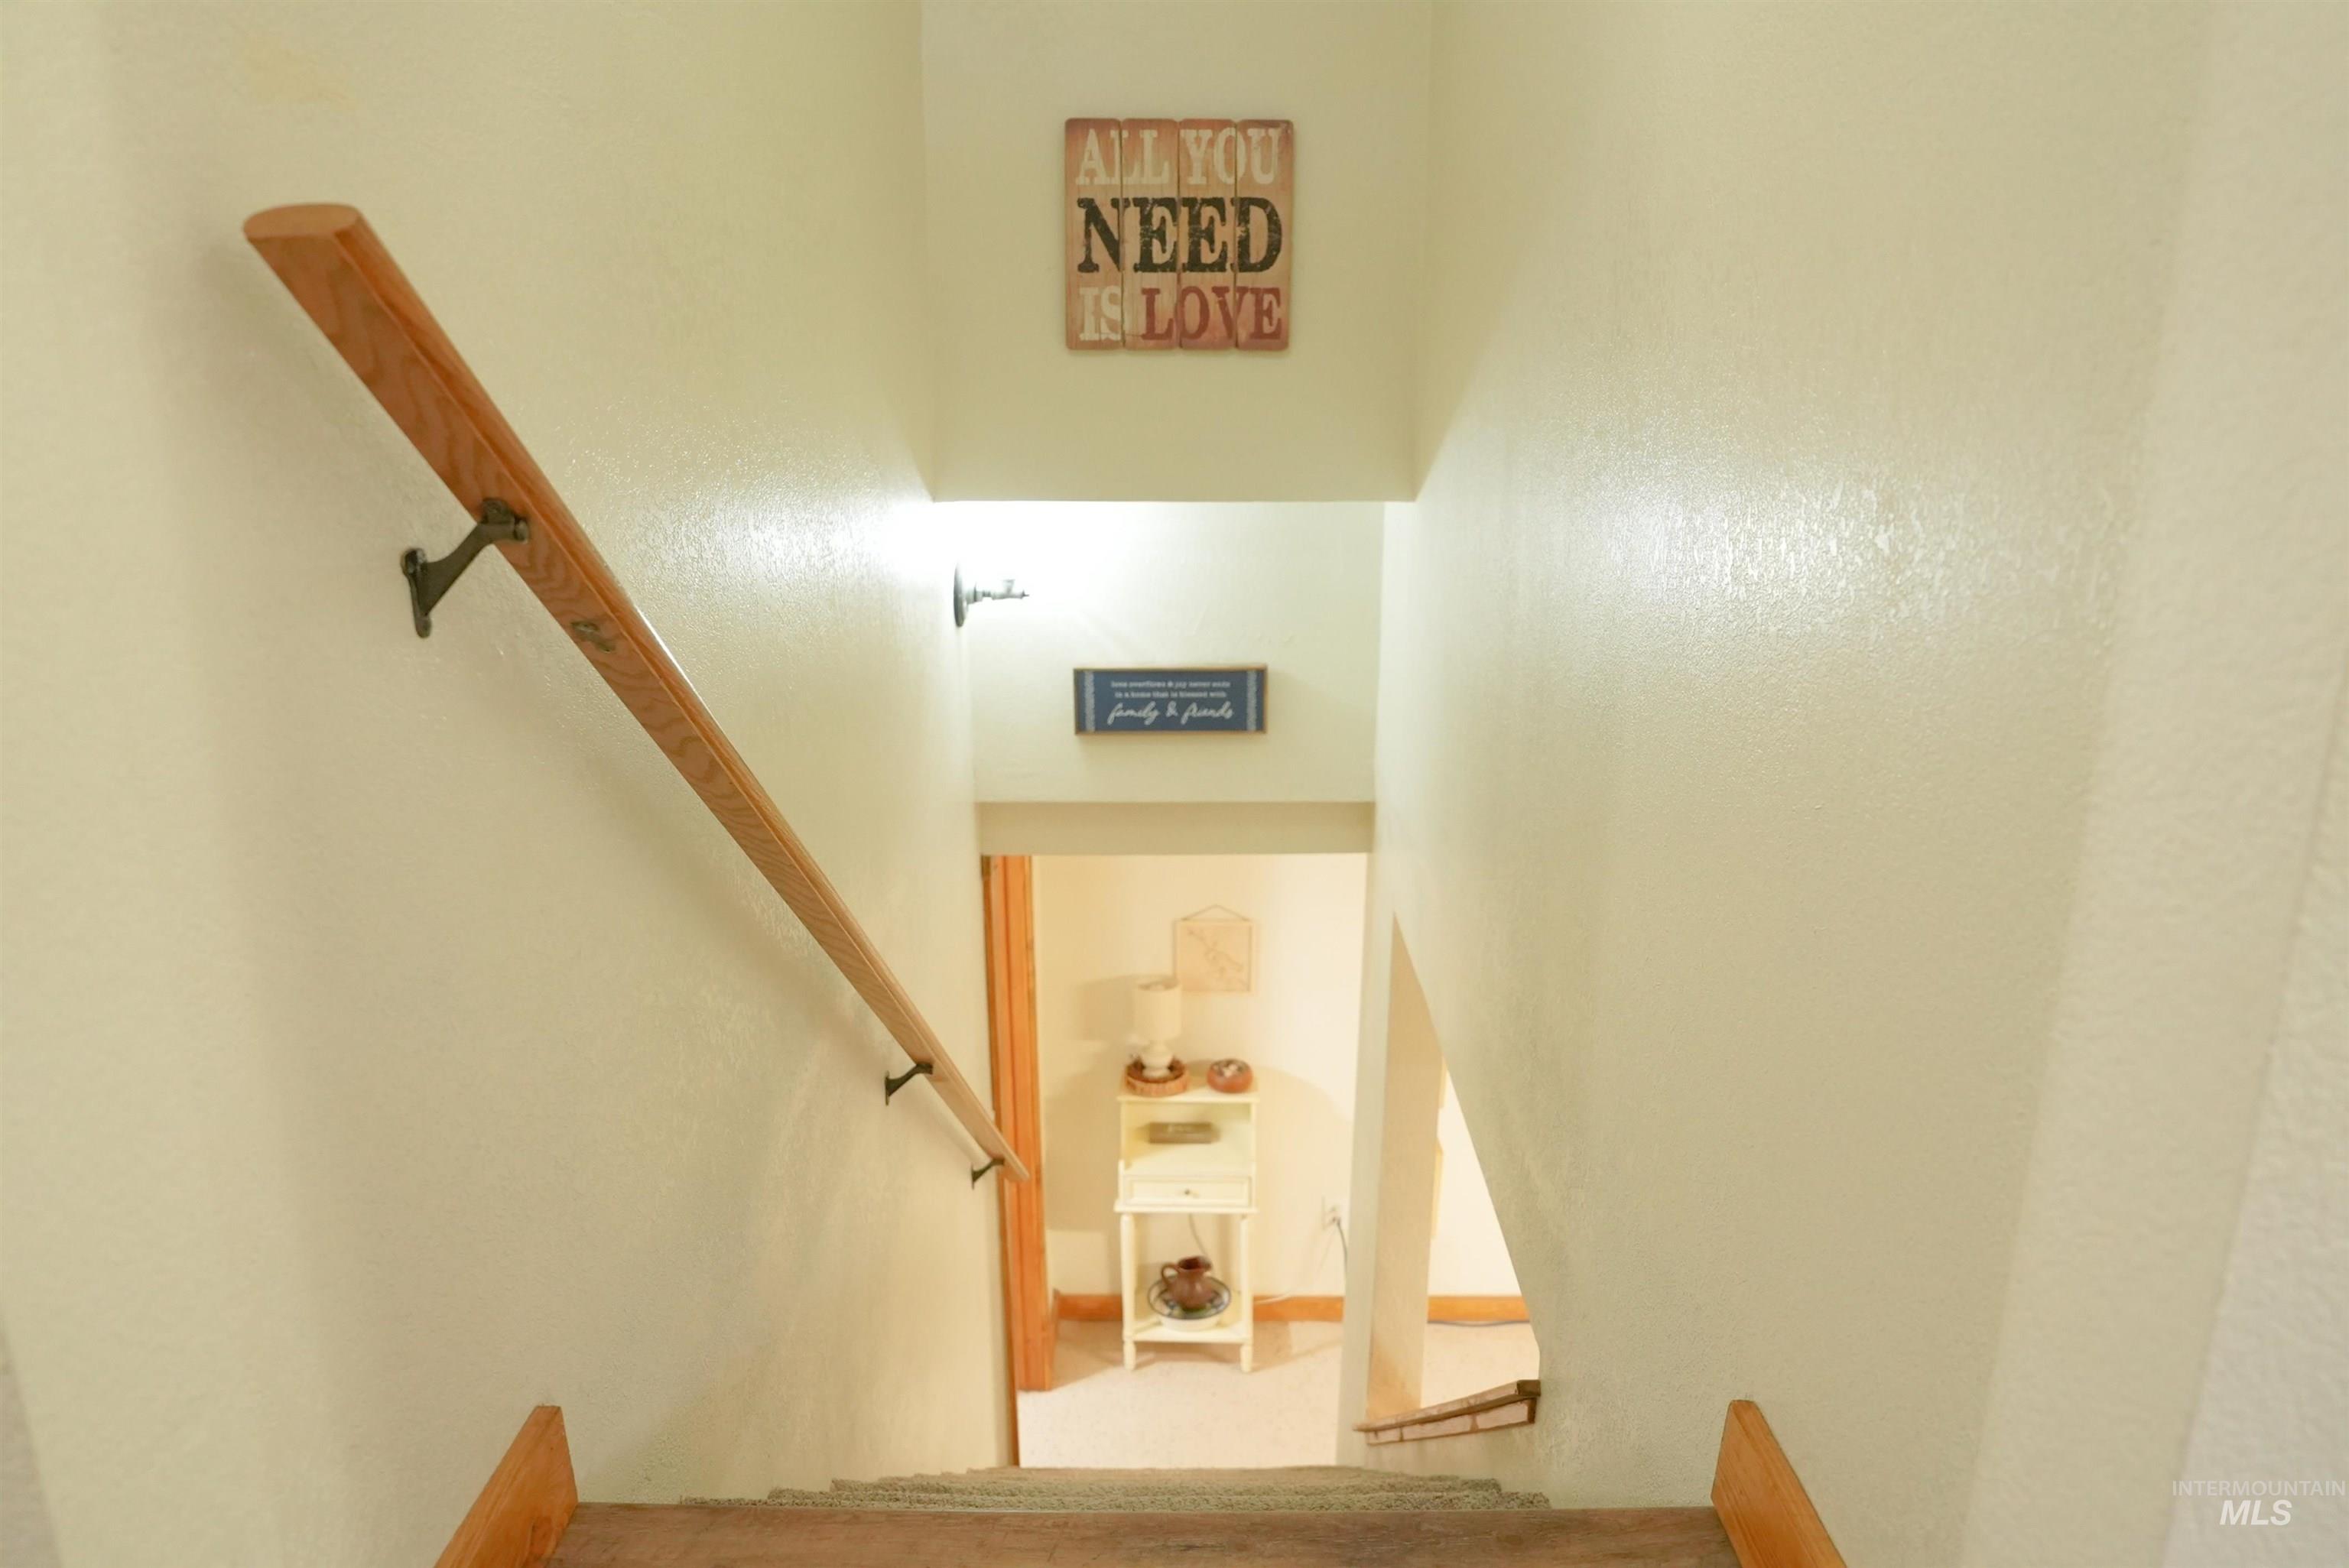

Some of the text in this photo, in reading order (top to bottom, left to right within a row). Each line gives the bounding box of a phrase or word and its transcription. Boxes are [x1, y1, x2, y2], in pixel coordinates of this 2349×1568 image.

[1076, 128, 1282, 185] ALL YOU
[1077, 196, 1282, 273] NEED
[1079, 285, 1281, 341] IS LOVE
[1165, 700, 1178, 718] &
